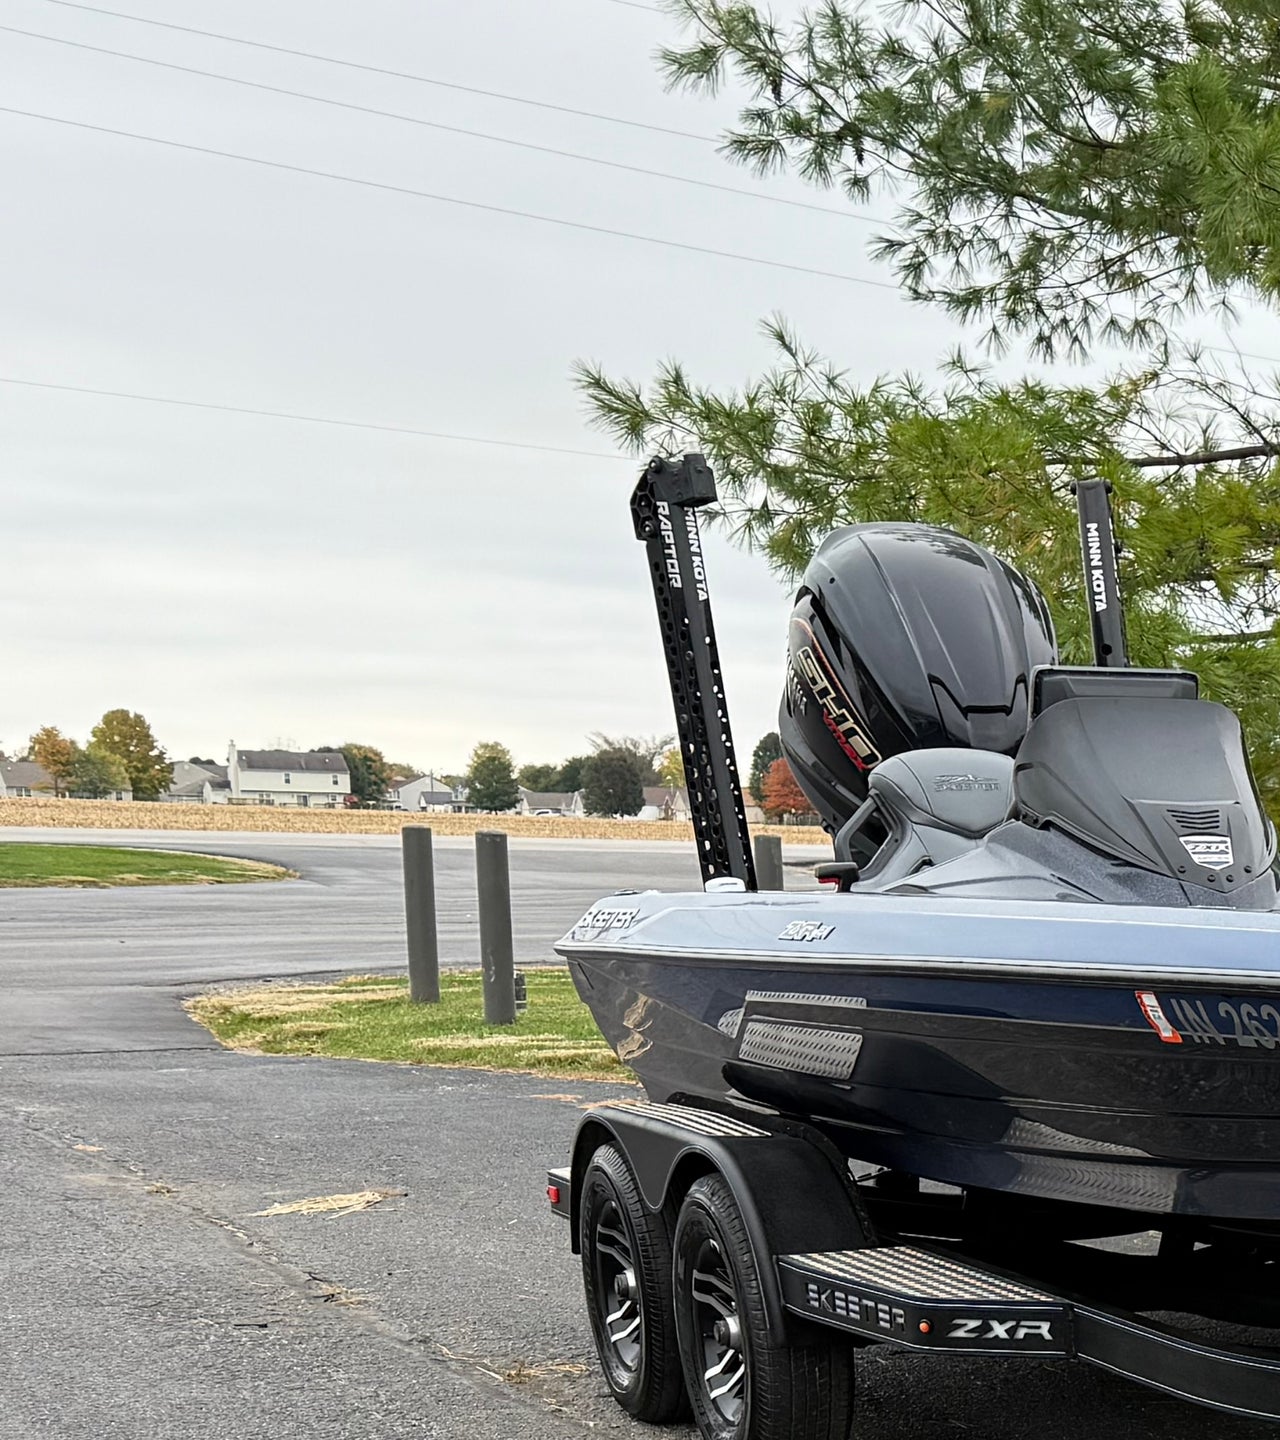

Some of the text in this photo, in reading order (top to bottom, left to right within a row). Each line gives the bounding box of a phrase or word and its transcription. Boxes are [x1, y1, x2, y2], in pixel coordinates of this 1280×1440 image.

[656, 501, 682, 588] RAPTOR
[684, 506, 708, 601] MINN KOTA
[1086, 523, 1107, 612] MINN KOTA
[797, 646, 883, 768] SHO
[1170, 998, 1226, 1045] IN
[805, 1283, 906, 1332] SKEETER
[946, 1319, 1053, 1341] ZXR
